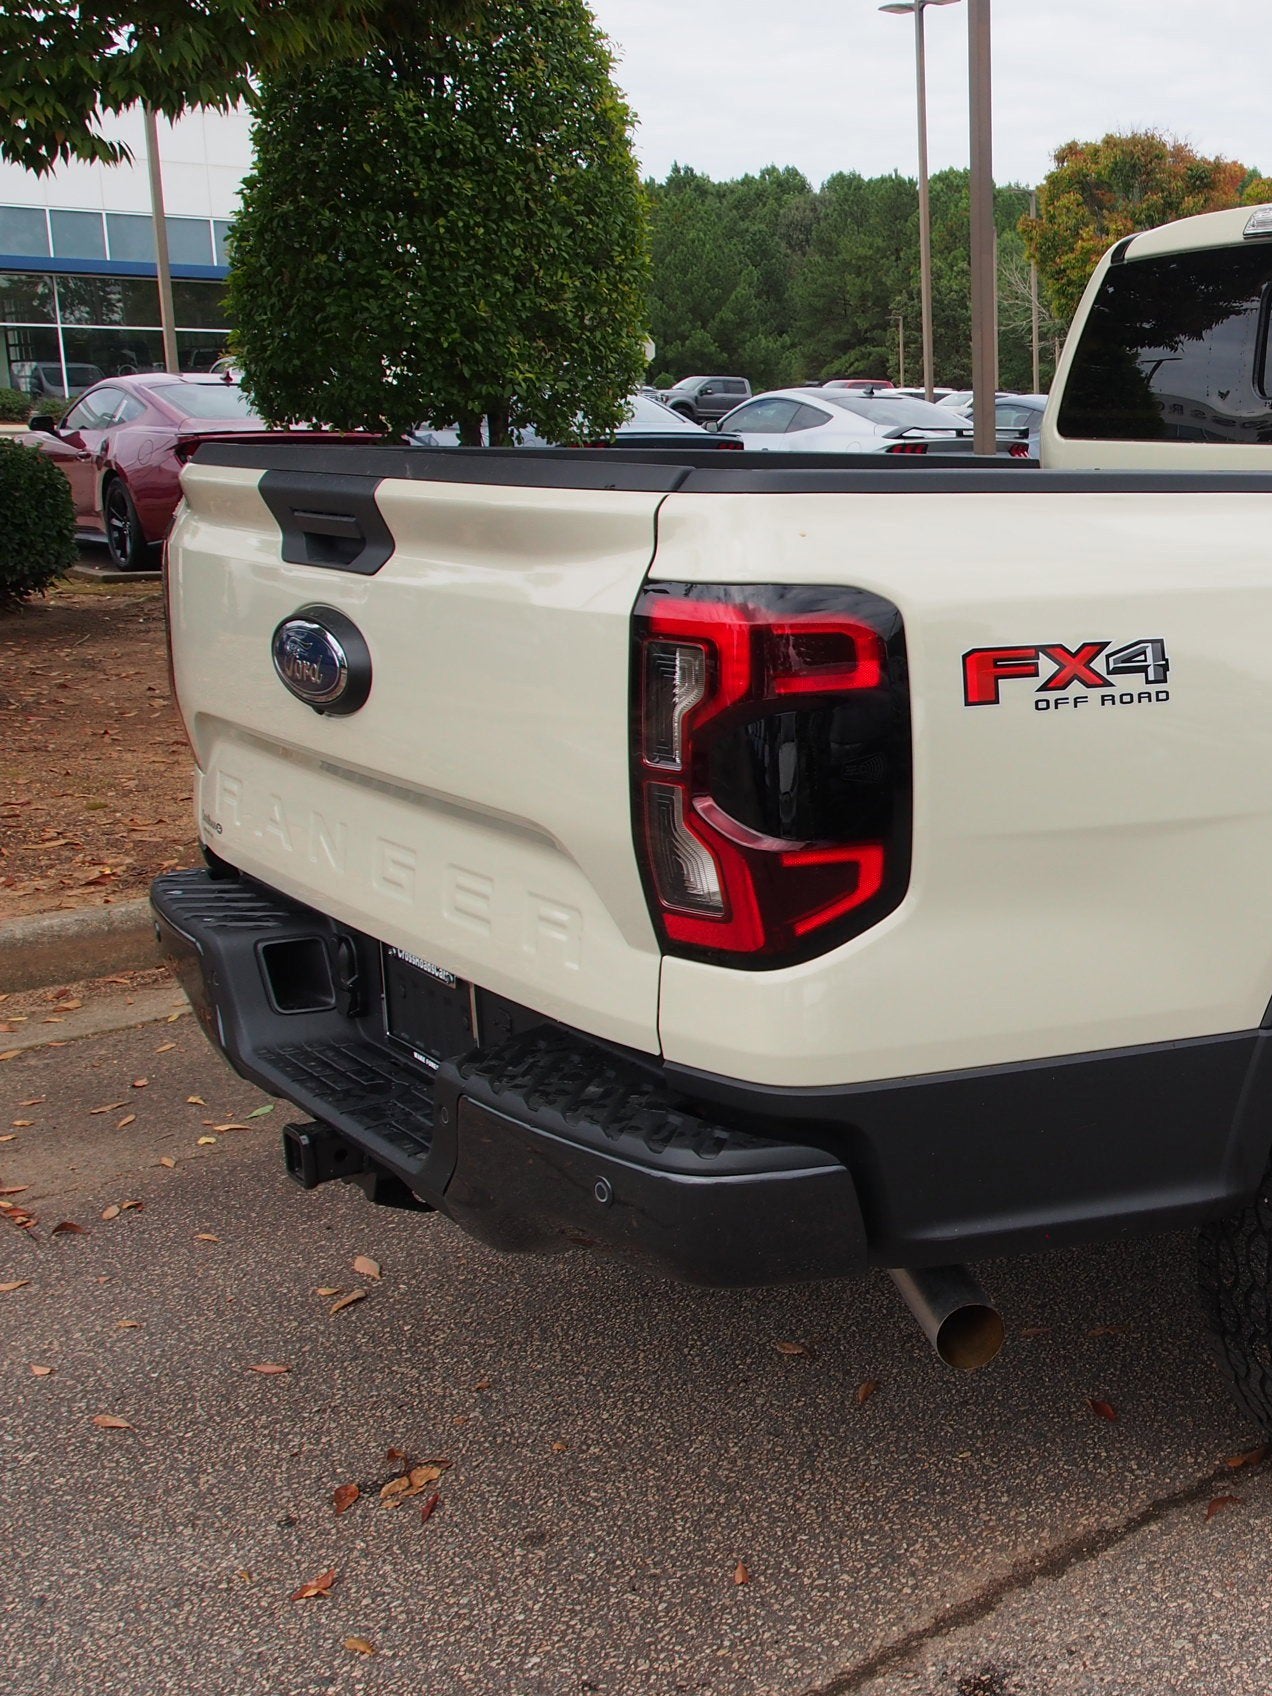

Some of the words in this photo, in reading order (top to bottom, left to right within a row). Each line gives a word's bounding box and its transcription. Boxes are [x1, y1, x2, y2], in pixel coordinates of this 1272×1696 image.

[284, 636, 323, 684] Ford
[961, 638, 1170, 706] FX4
[1034, 695, 1089, 711] OFF
[1101, 690, 1170, 706] ROAD
[216, 769, 584, 970] RANGER
